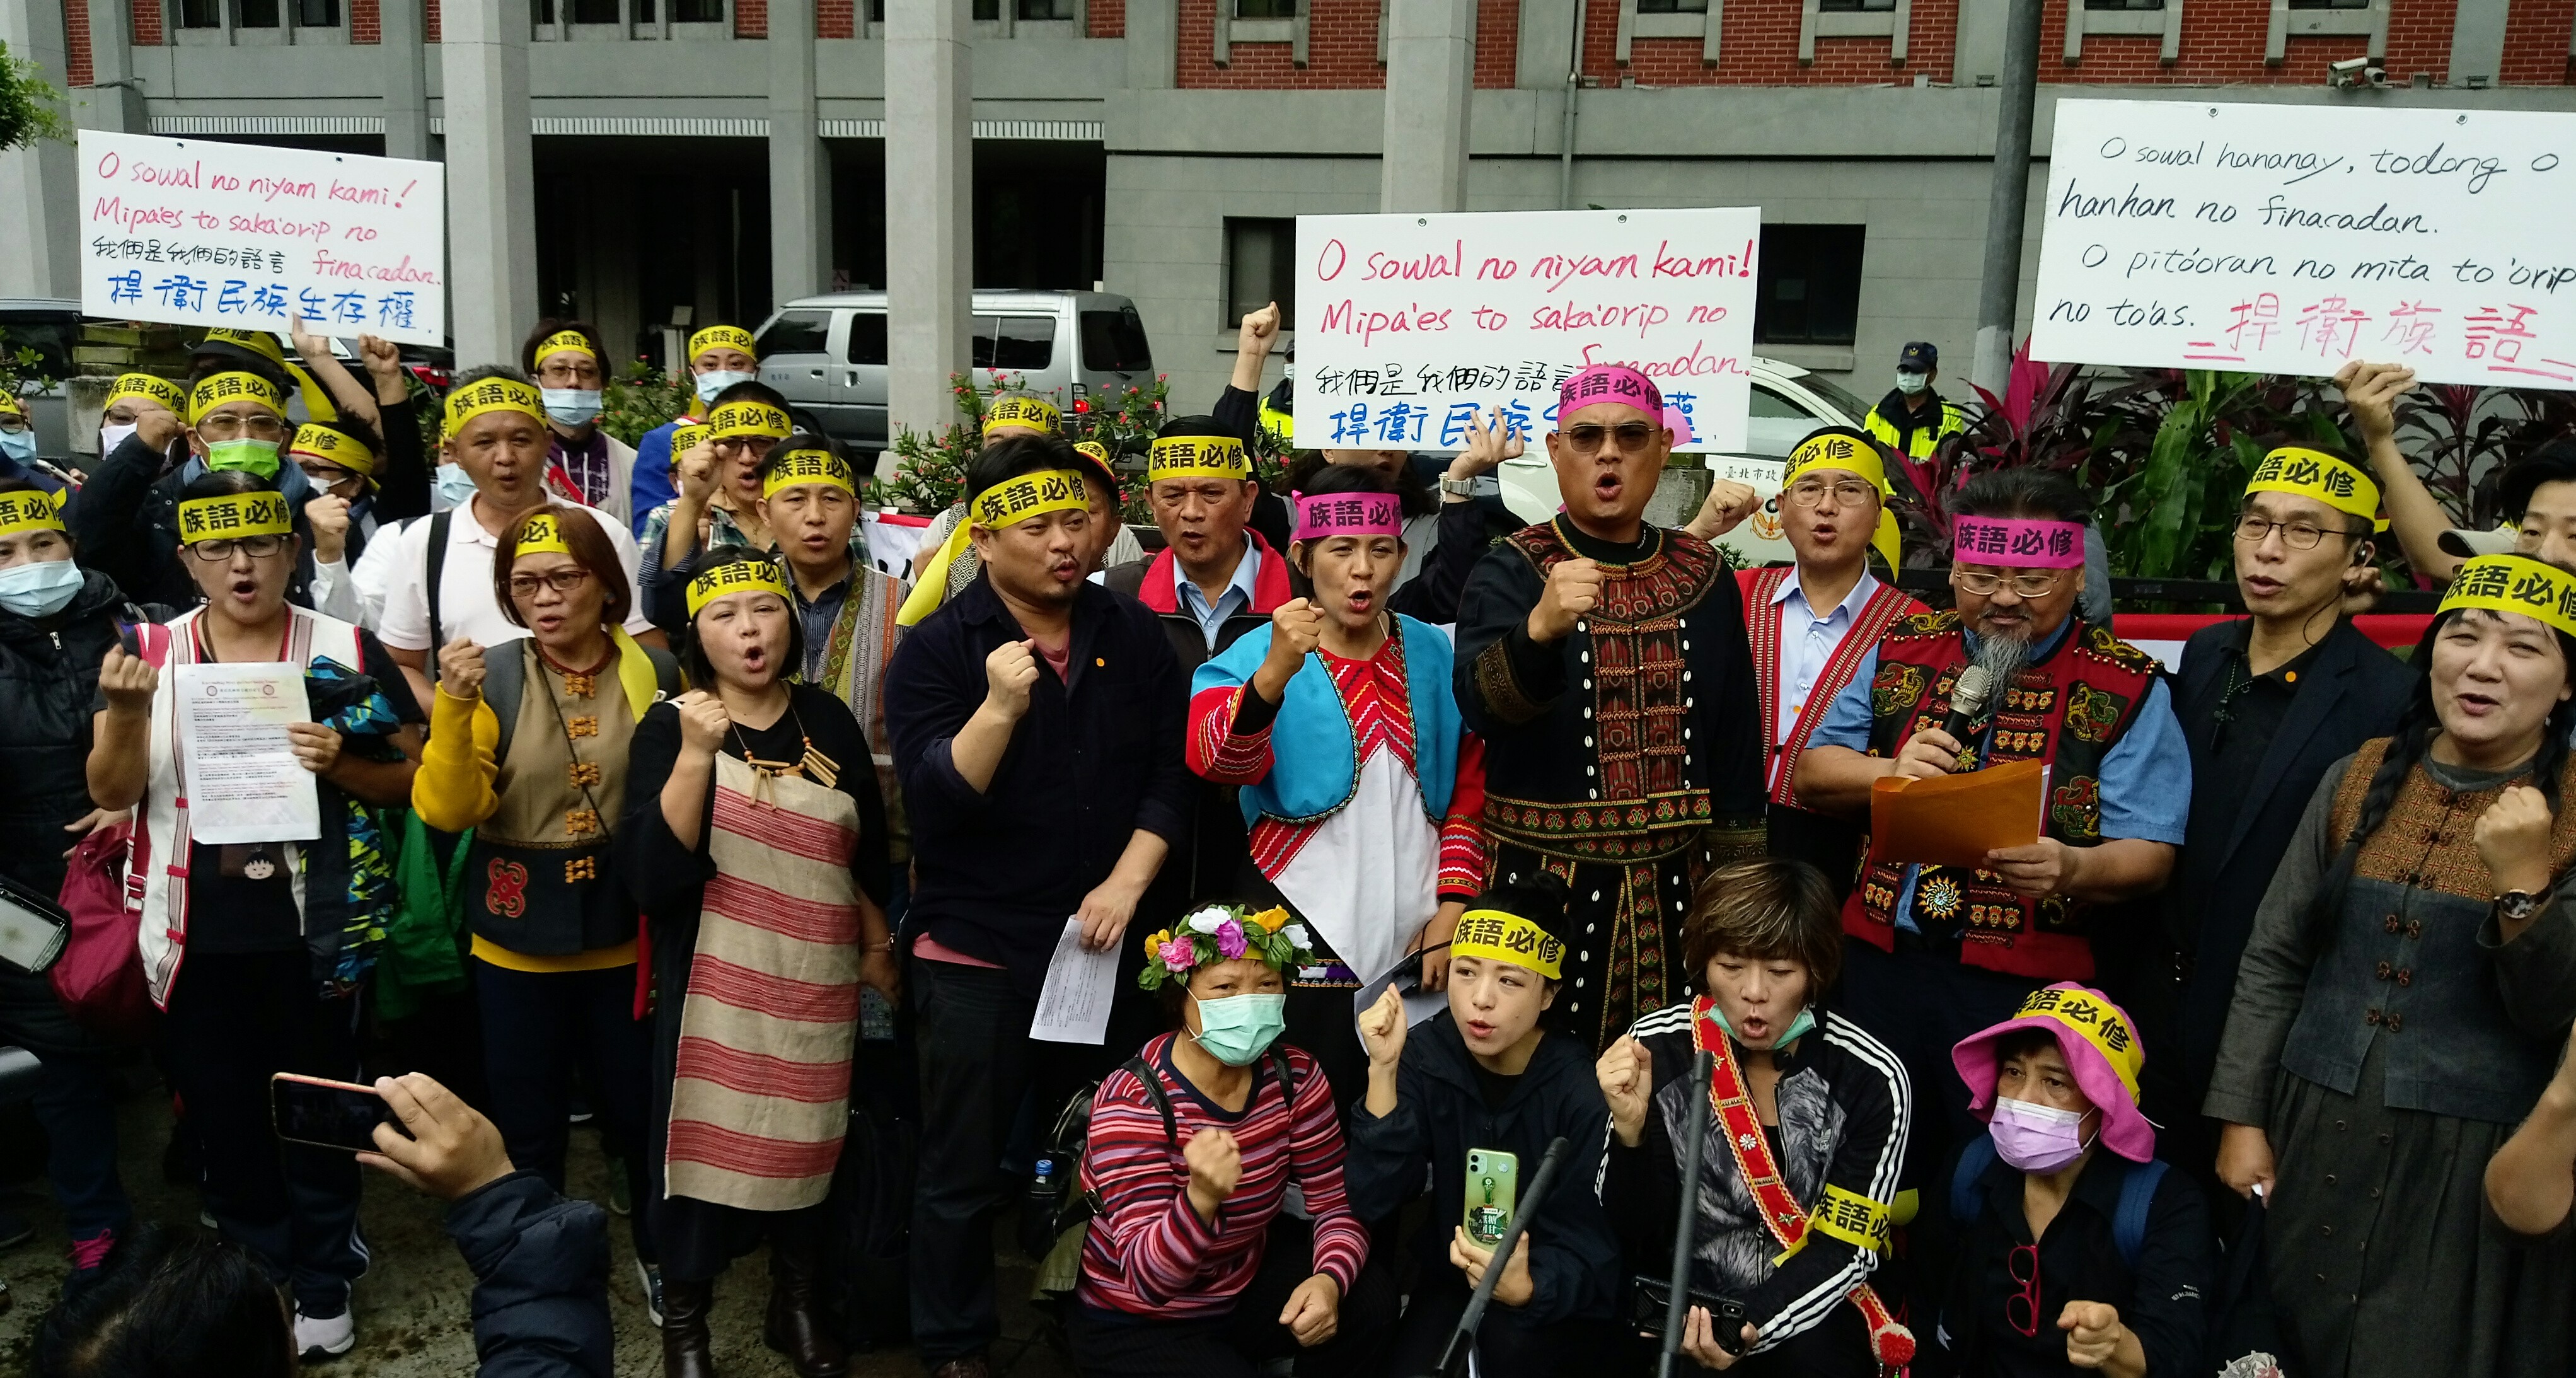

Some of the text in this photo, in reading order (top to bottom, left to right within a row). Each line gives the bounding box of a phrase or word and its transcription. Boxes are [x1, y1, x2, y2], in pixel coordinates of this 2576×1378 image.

[132, 161, 199, 189] sowal
[212, 174, 239, 190] no
[249, 177, 316, 201] niyam
[2137, 141, 2204, 168] sowal
[2369, 141, 2508, 194] todong
[2058, 178, 2175, 220] hanhan
[2196, 200, 2236, 223] no
[191, 211, 219, 230] to
[345, 225, 378, 241] no
[92, 236, 286, 274] 我們是我們的語言
[1361, 240, 1462, 281] sowal
[1477, 257, 1517, 281] no
[1530, 253, 1638, 293] niyam
[1652, 240, 1754, 279] kami!
[2294, 260, 2335, 281] no
[2350, 257, 2430, 283] mita
[2452, 258, 2494, 282] to
[1472, 304, 1508, 331] to
[1687, 306, 1727, 323] no
[2049, 299, 2090, 322] no
[2225, 292, 2538, 364] 捍衛族語
[109, 378, 185, 412] 族語必修
[1559, 373, 1663, 411] 族語必修
[985, 402, 1060, 431] 族語必修
[1153, 443, 1244, 471] 族語必修
[1725, 466, 1783, 482] 臺北市政
[981, 474, 1086, 523] 族語必修
[183, 500, 290, 535] 族語必修
[1956, 522, 2074, 557] 族語必修
[1455, 918, 1560, 964] 族語必修
